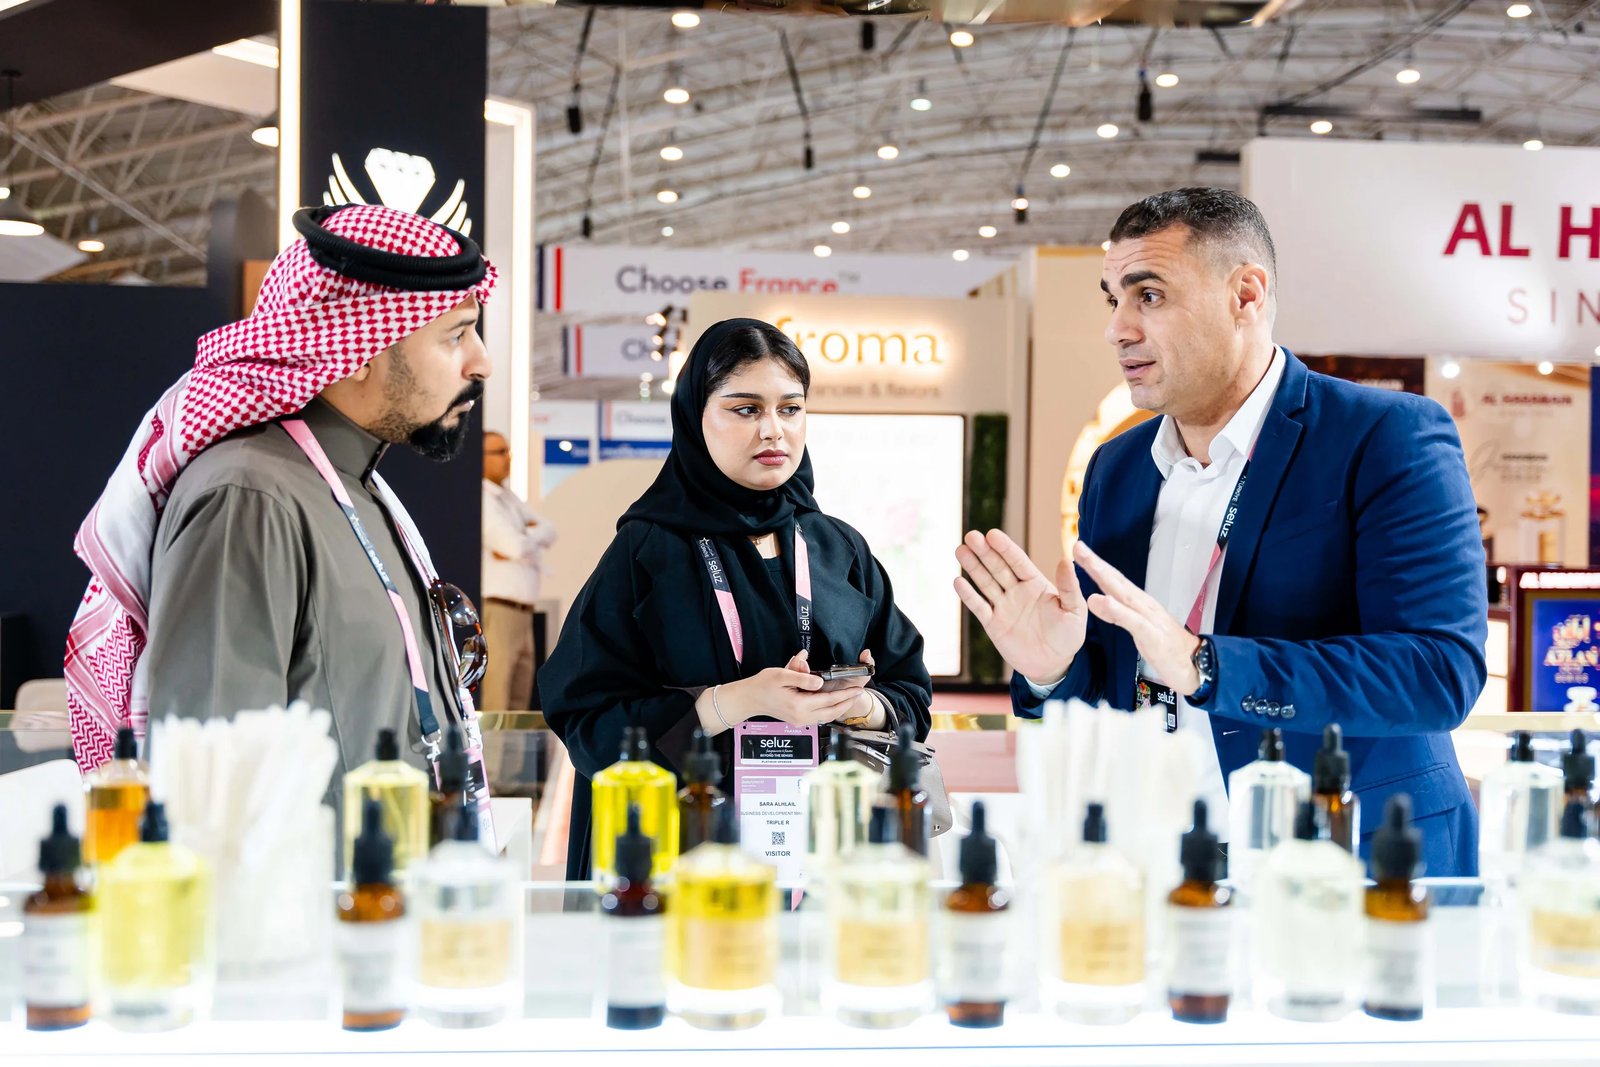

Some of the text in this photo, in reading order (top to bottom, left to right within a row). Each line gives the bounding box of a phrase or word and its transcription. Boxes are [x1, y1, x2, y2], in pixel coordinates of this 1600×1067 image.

[1443, 203, 1530, 257] AL
[616, 266, 728, 293] Choose
[1220, 506, 1238, 539] seluz
[708, 560, 723, 586] seluz
[800, 604, 810, 631] seluz
[1157, 691, 1176, 705] seluz
[760, 736, 792, 748] seluz
